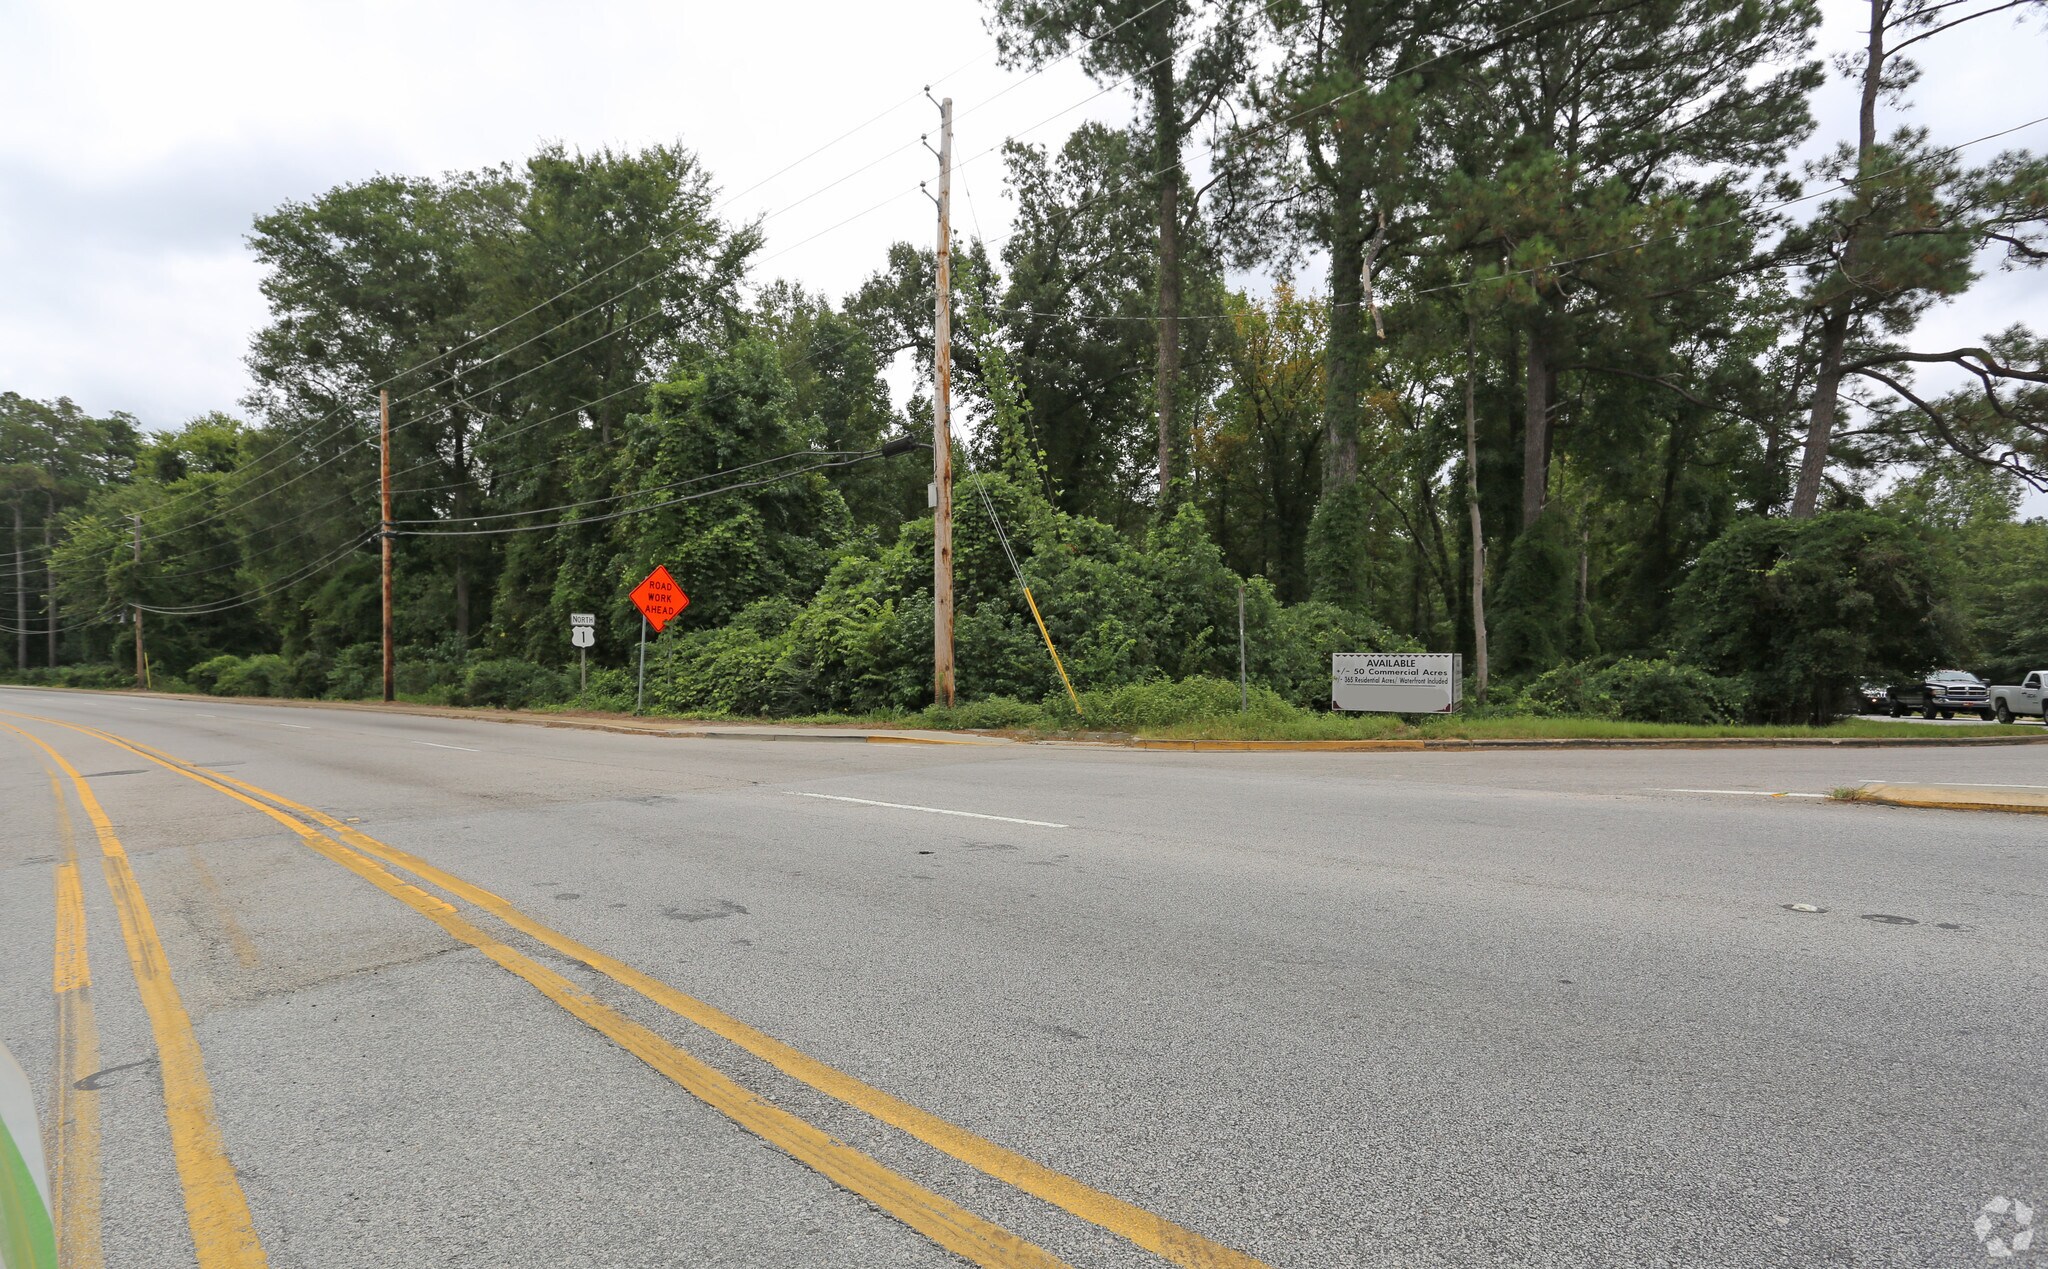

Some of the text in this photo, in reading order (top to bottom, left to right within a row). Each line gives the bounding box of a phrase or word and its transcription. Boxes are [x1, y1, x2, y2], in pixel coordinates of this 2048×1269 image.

[649, 581, 672, 591] ROAD
[648, 593, 672, 603] WORK
[645, 605, 674, 615] AHEAD
[582, 631, 585, 643] 1
[1366, 660, 1416, 668] AVAILABLE
[1368, 668, 1419, 676] Commercial
[1355, 676, 1380, 684] Residential
[1427, 677, 1449, 685] Included
